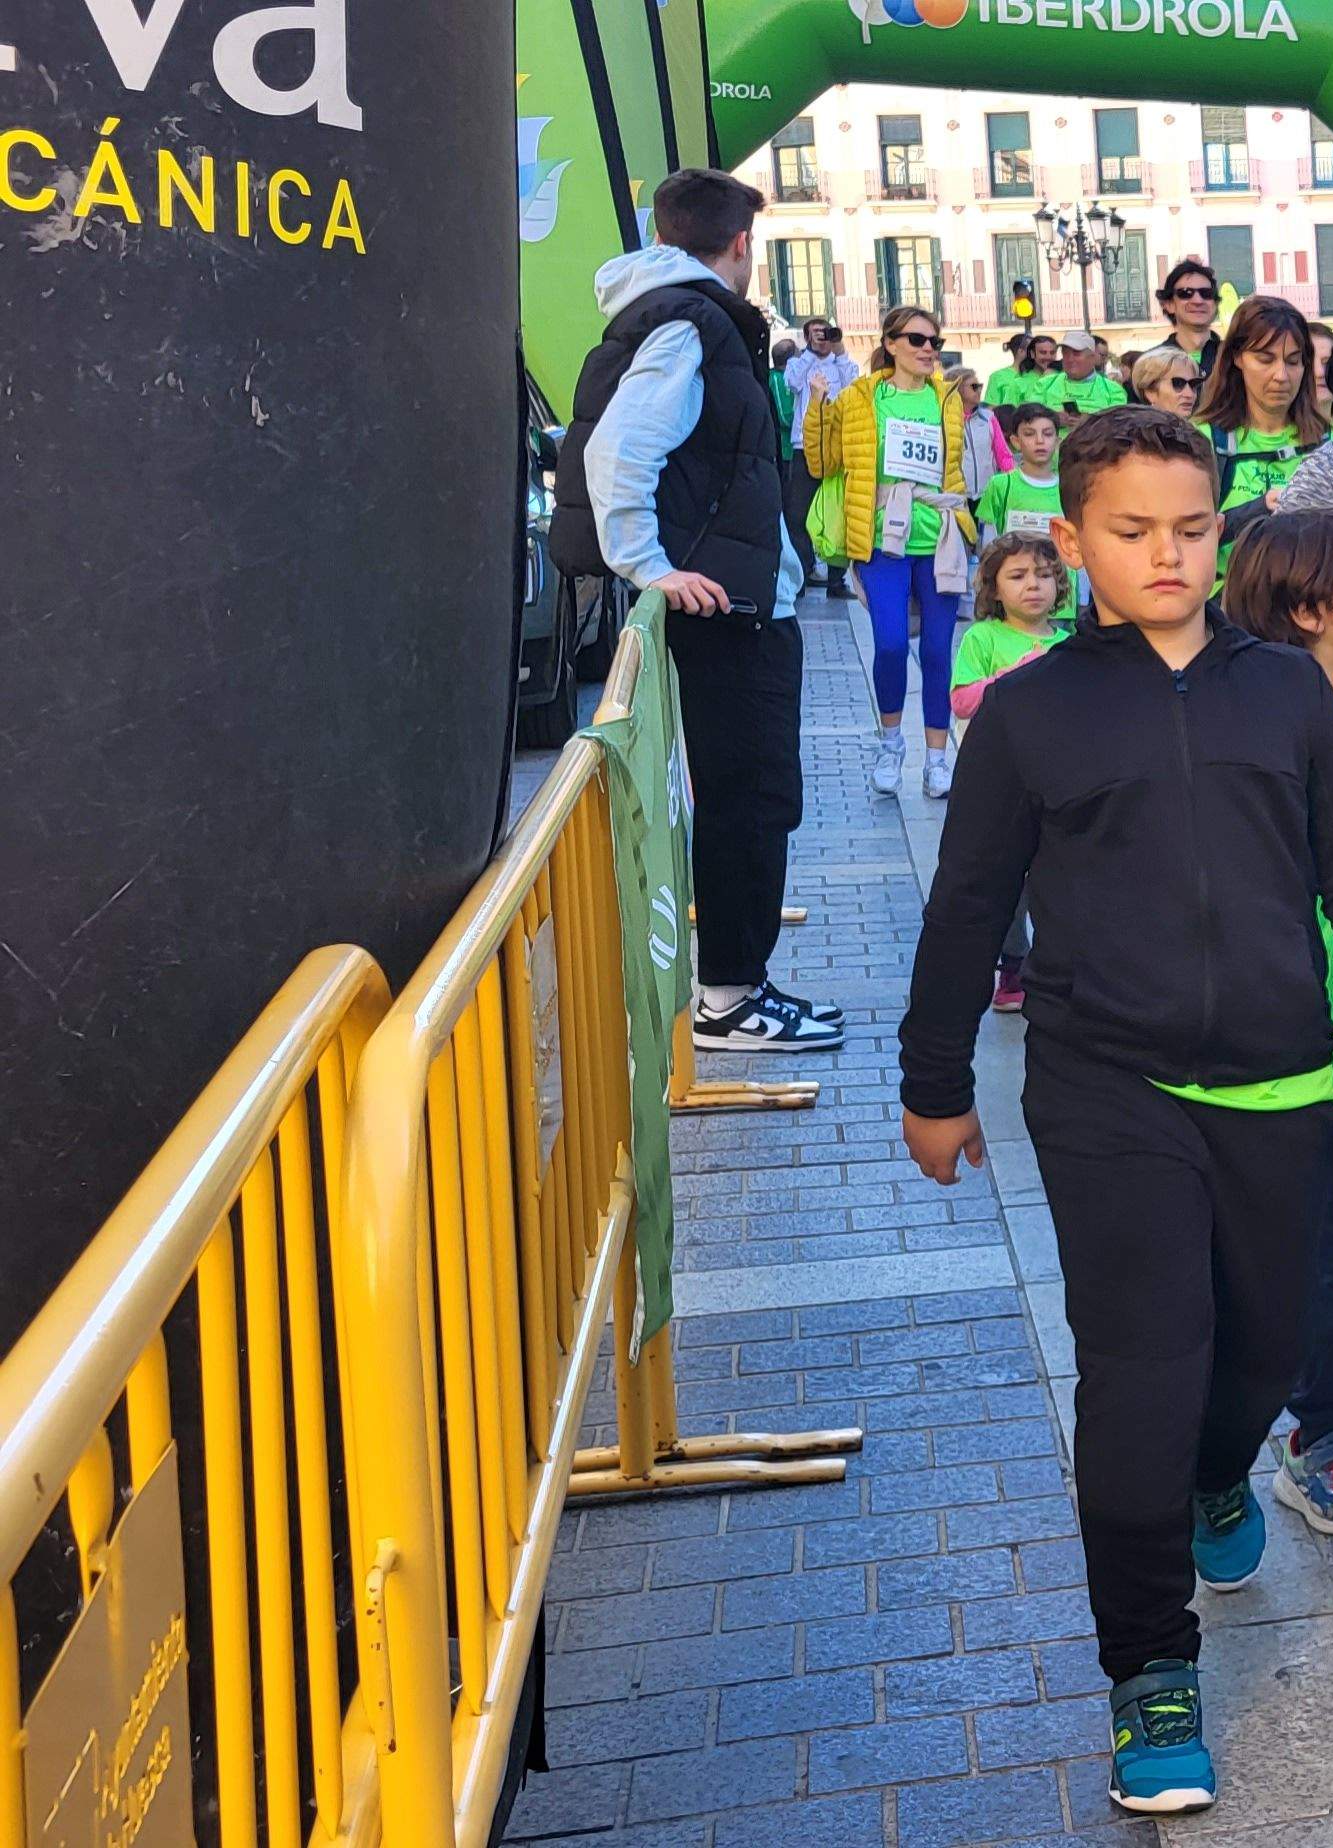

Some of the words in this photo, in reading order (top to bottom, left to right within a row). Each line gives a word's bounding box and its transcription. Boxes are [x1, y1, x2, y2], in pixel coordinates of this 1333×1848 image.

[979, 0, 1300, 42] IBERDROLA
[0, 0, 363, 131] va
[0, 117, 366, 255] CÁNICA
[902, 440, 938, 465] 335
